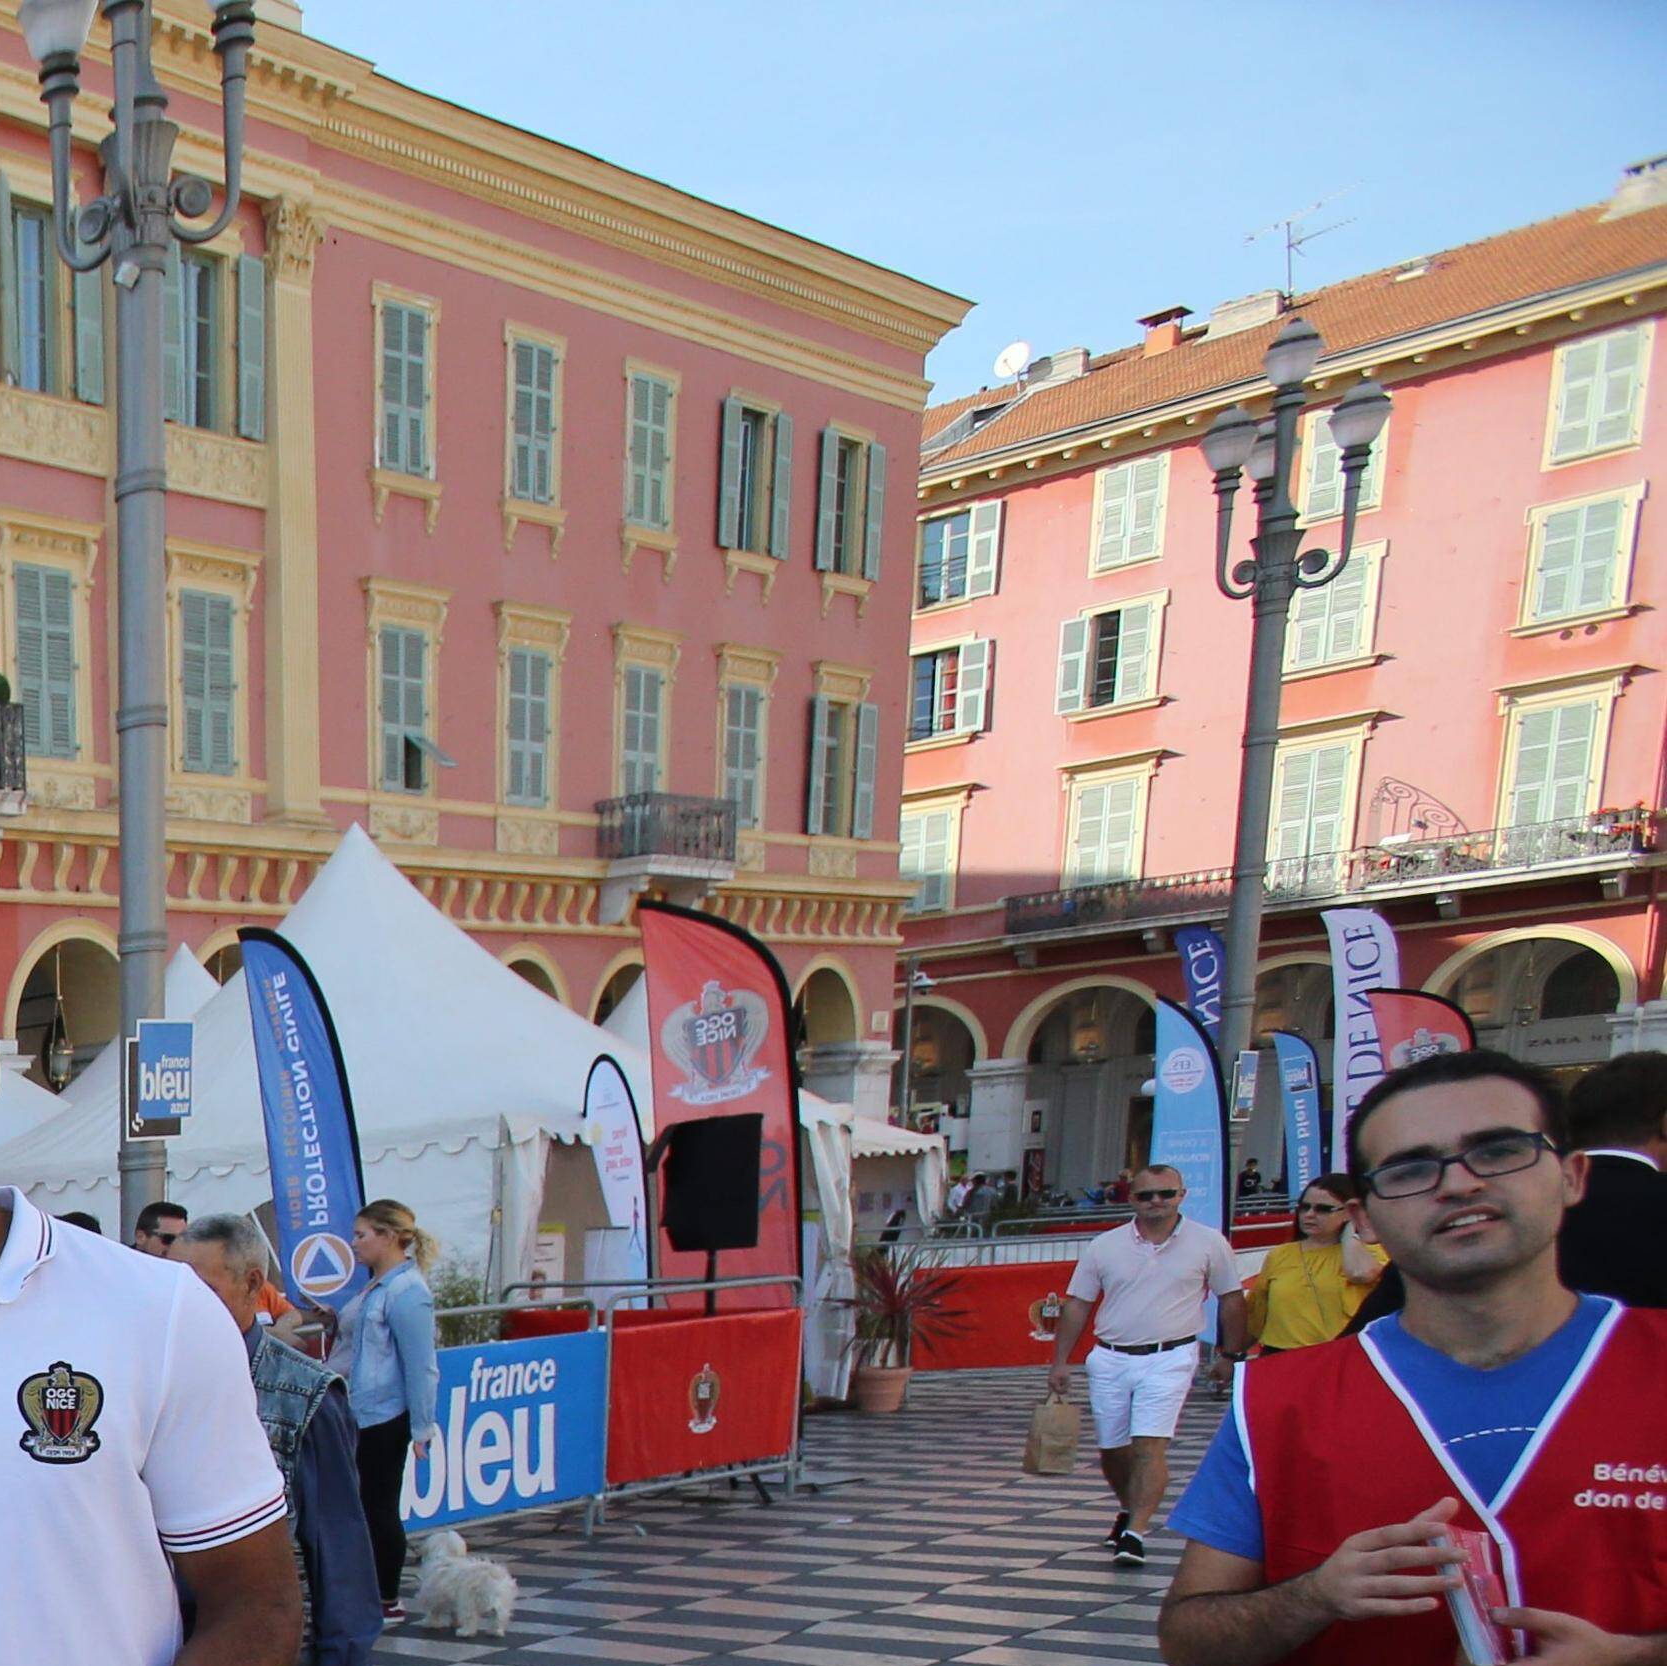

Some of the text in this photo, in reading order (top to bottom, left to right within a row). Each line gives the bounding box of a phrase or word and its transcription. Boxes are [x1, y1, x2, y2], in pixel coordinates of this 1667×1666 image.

[161, 1053, 190, 1069] france
[140, 1062, 190, 1101] bleu
[470, 1356, 557, 1403] france
[46, 1388, 77, 1399] OGC
[46, 1399, 76, 1410] NICE
[399, 1386, 556, 1521] bleu
[1573, 1489, 1666, 1511] don de
